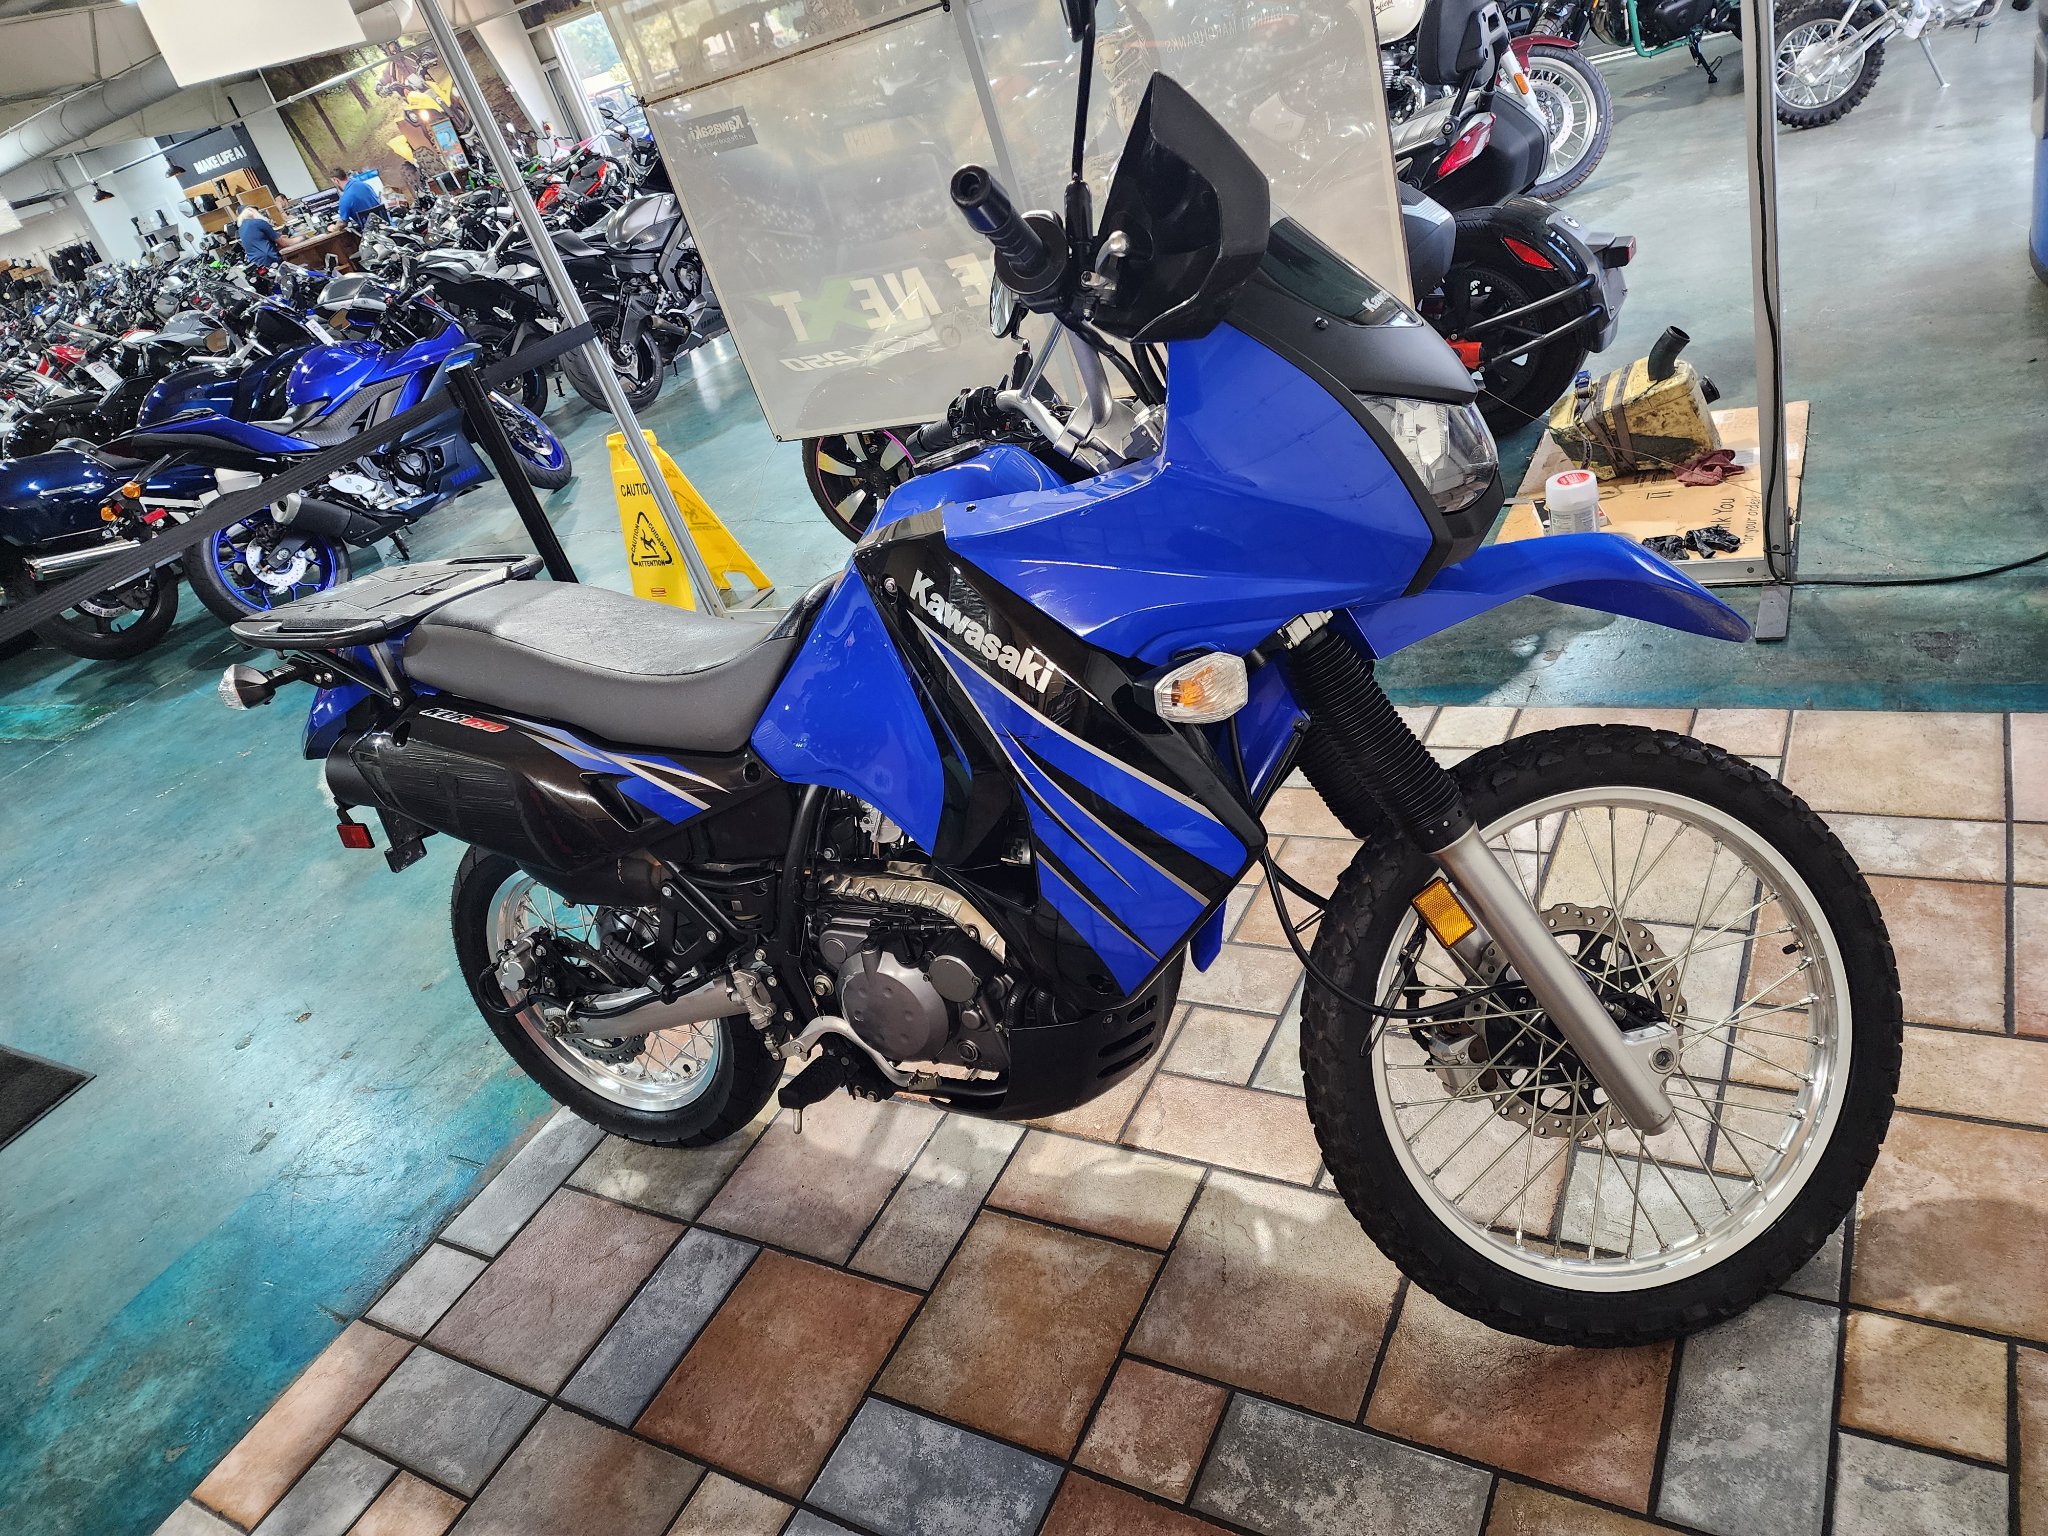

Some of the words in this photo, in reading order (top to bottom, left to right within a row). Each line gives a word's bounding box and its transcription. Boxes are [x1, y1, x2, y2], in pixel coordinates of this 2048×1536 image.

[193, 155, 220, 175] MAKE
[216, 148, 236, 166] LIFE
[1712, 497, 1735, 516] You
[631, 524, 640, 553] CAUTION
[648, 522, 668, 553] CUIDADO
[1746, 518, 1760, 534] your
[638, 560, 666, 568] ATTENTION
[909, 569, 1056, 693] Kawasaki
